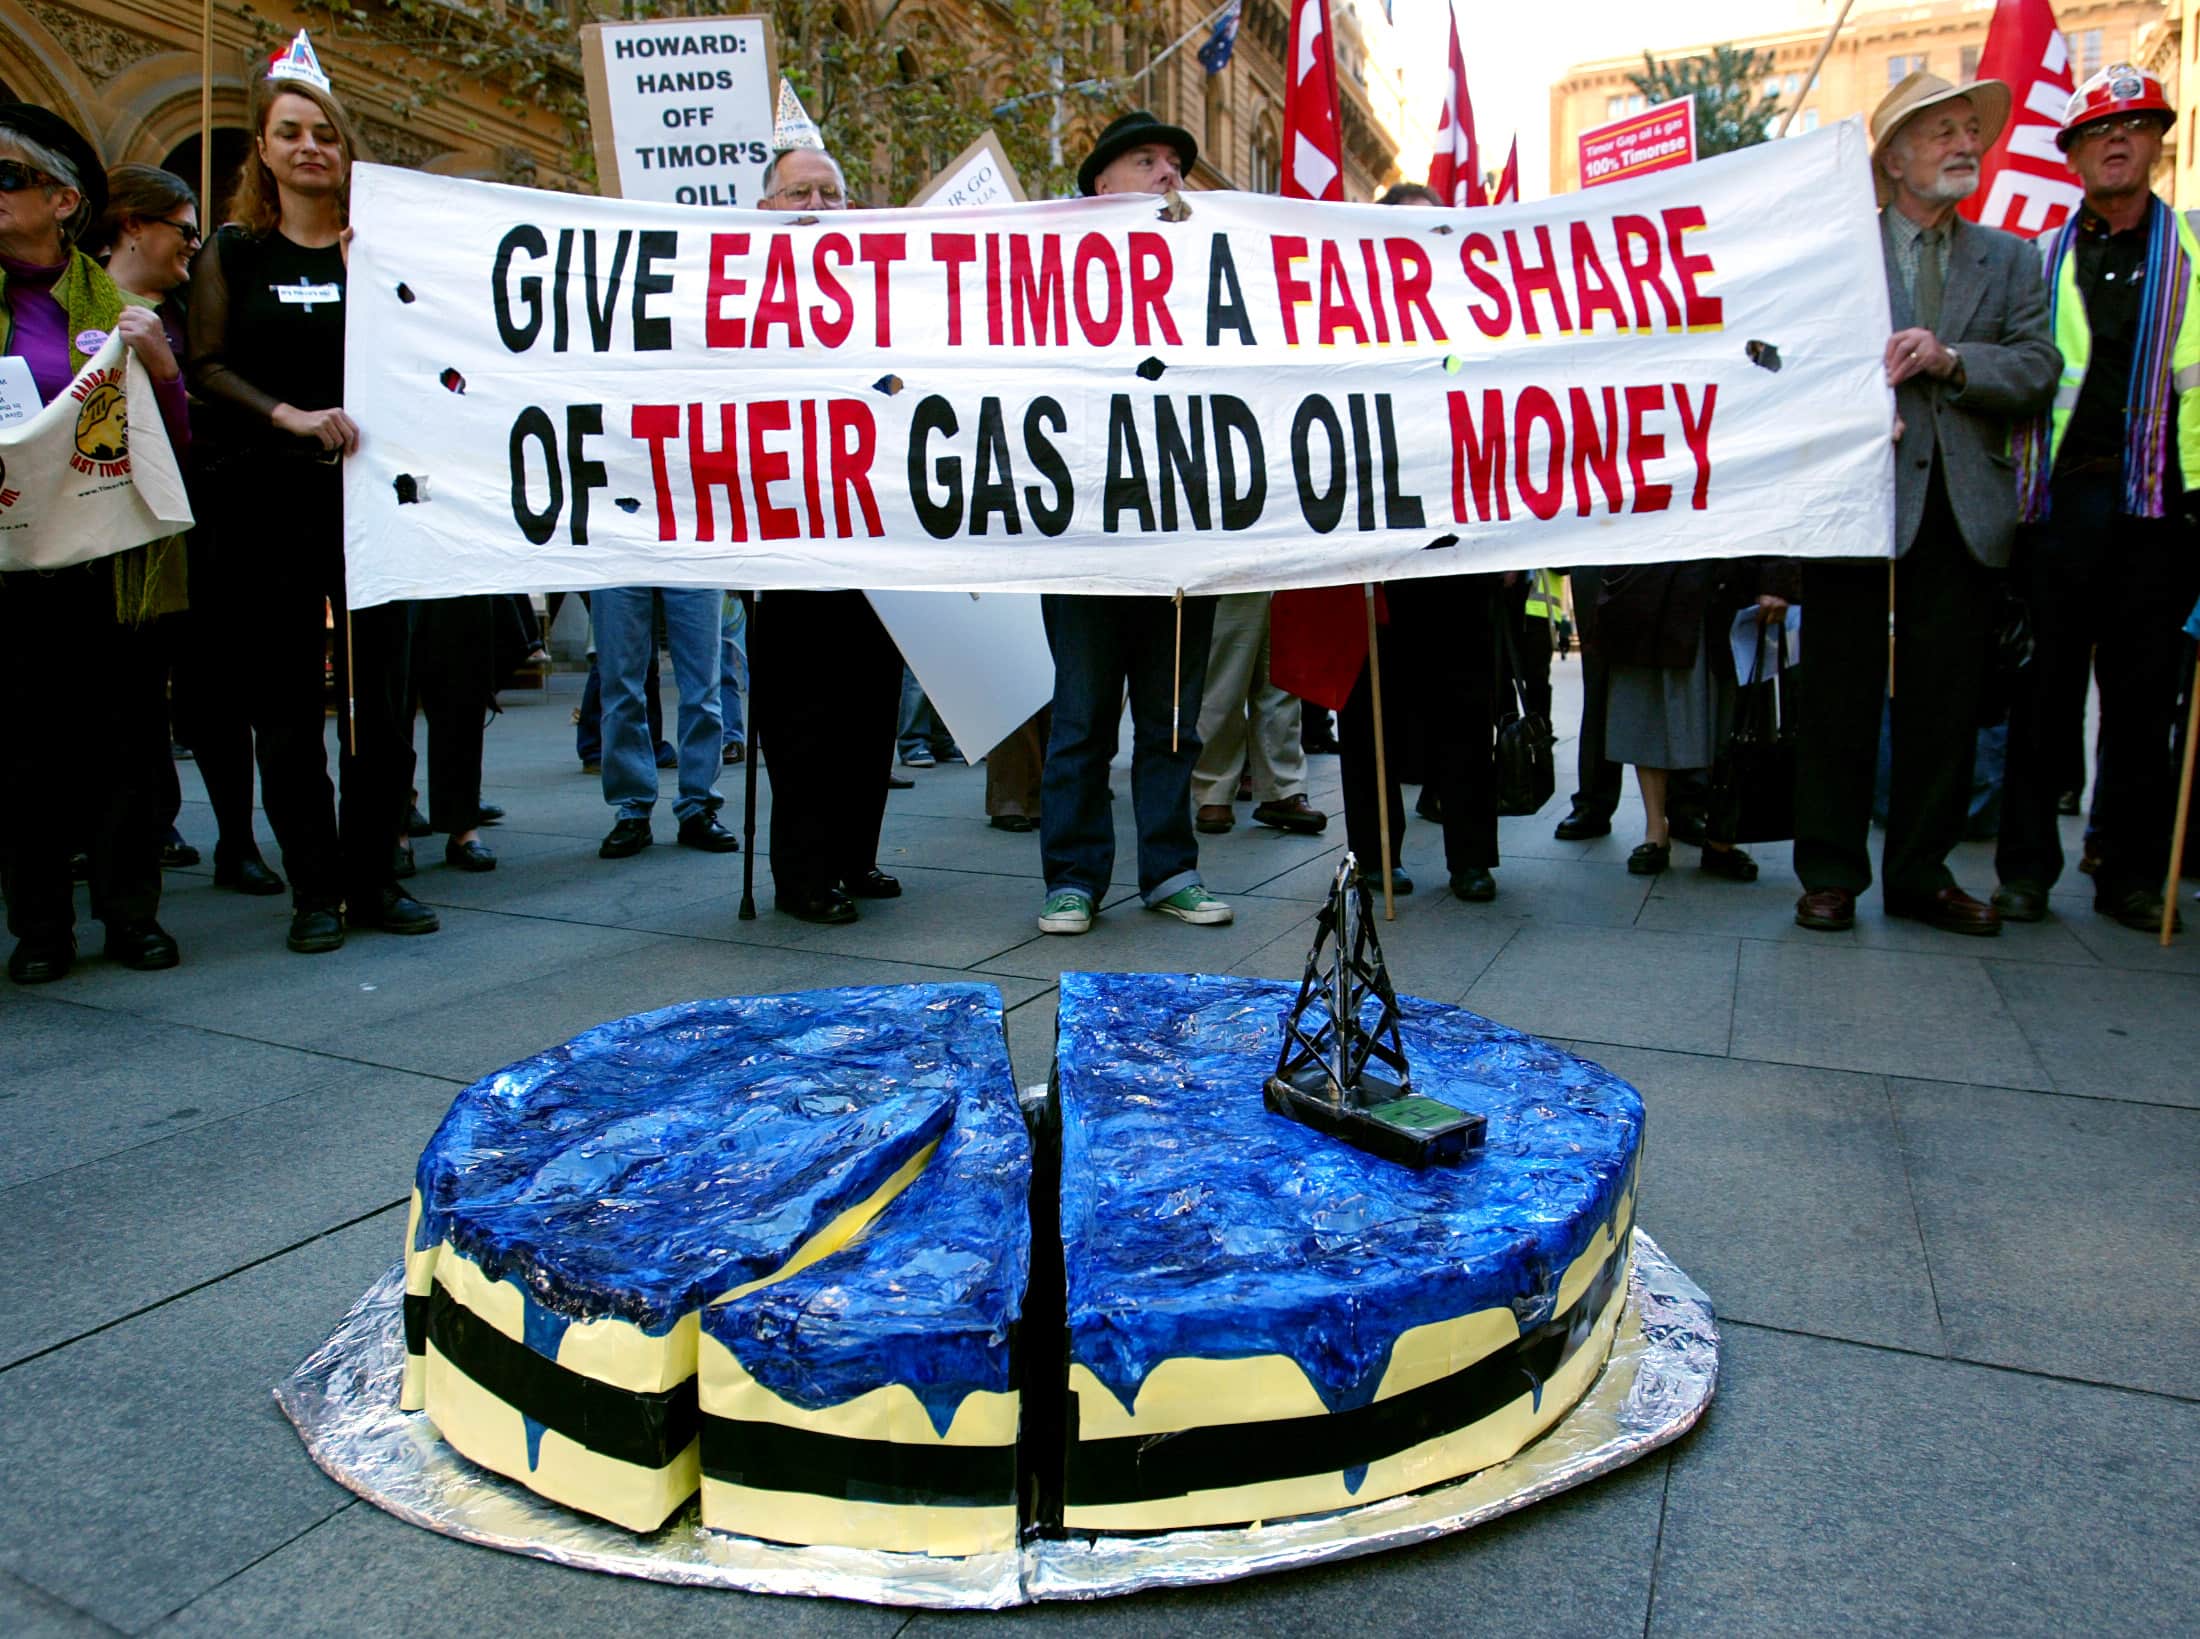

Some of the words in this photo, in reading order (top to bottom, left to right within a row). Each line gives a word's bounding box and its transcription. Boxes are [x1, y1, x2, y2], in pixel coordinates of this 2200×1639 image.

[615, 34, 747, 59] HOWARD:
[636, 70, 733, 94] HANDS
[662, 107, 714, 128] OFF
[1585, 141, 1615, 158] Timor
[1616, 132, 1638, 149] Gap
[1639, 125, 1653, 141] oil
[1653, 123, 1663, 136] &
[1664, 118, 1684, 136] gas
[635, 141, 768, 169] TIMOR'S
[1585, 156, 1620, 178] 100%
[1620, 135, 1687, 166] Timorese
[967, 166, 992, 193] GO
[675, 184, 737, 206] OIL!
[491, 224, 678, 354] GIVE
[705, 232, 907, 349] EAST
[931, 231, 1183, 347] TIMOR
[1206, 233, 1257, 346] A
[1270, 235, 1449, 348] FAIR
[1459, 205, 1724, 339] SHARE
[71, 368, 106, 403] HANDS
[509, 403, 608, 546] OF
[631, 397, 886, 543] THEIR
[907, 394, 1075, 540] GAS
[1103, 393, 1268, 535] AND
[1290, 393, 1426, 532] OIL
[1447, 383, 1718, 524] MONEY
